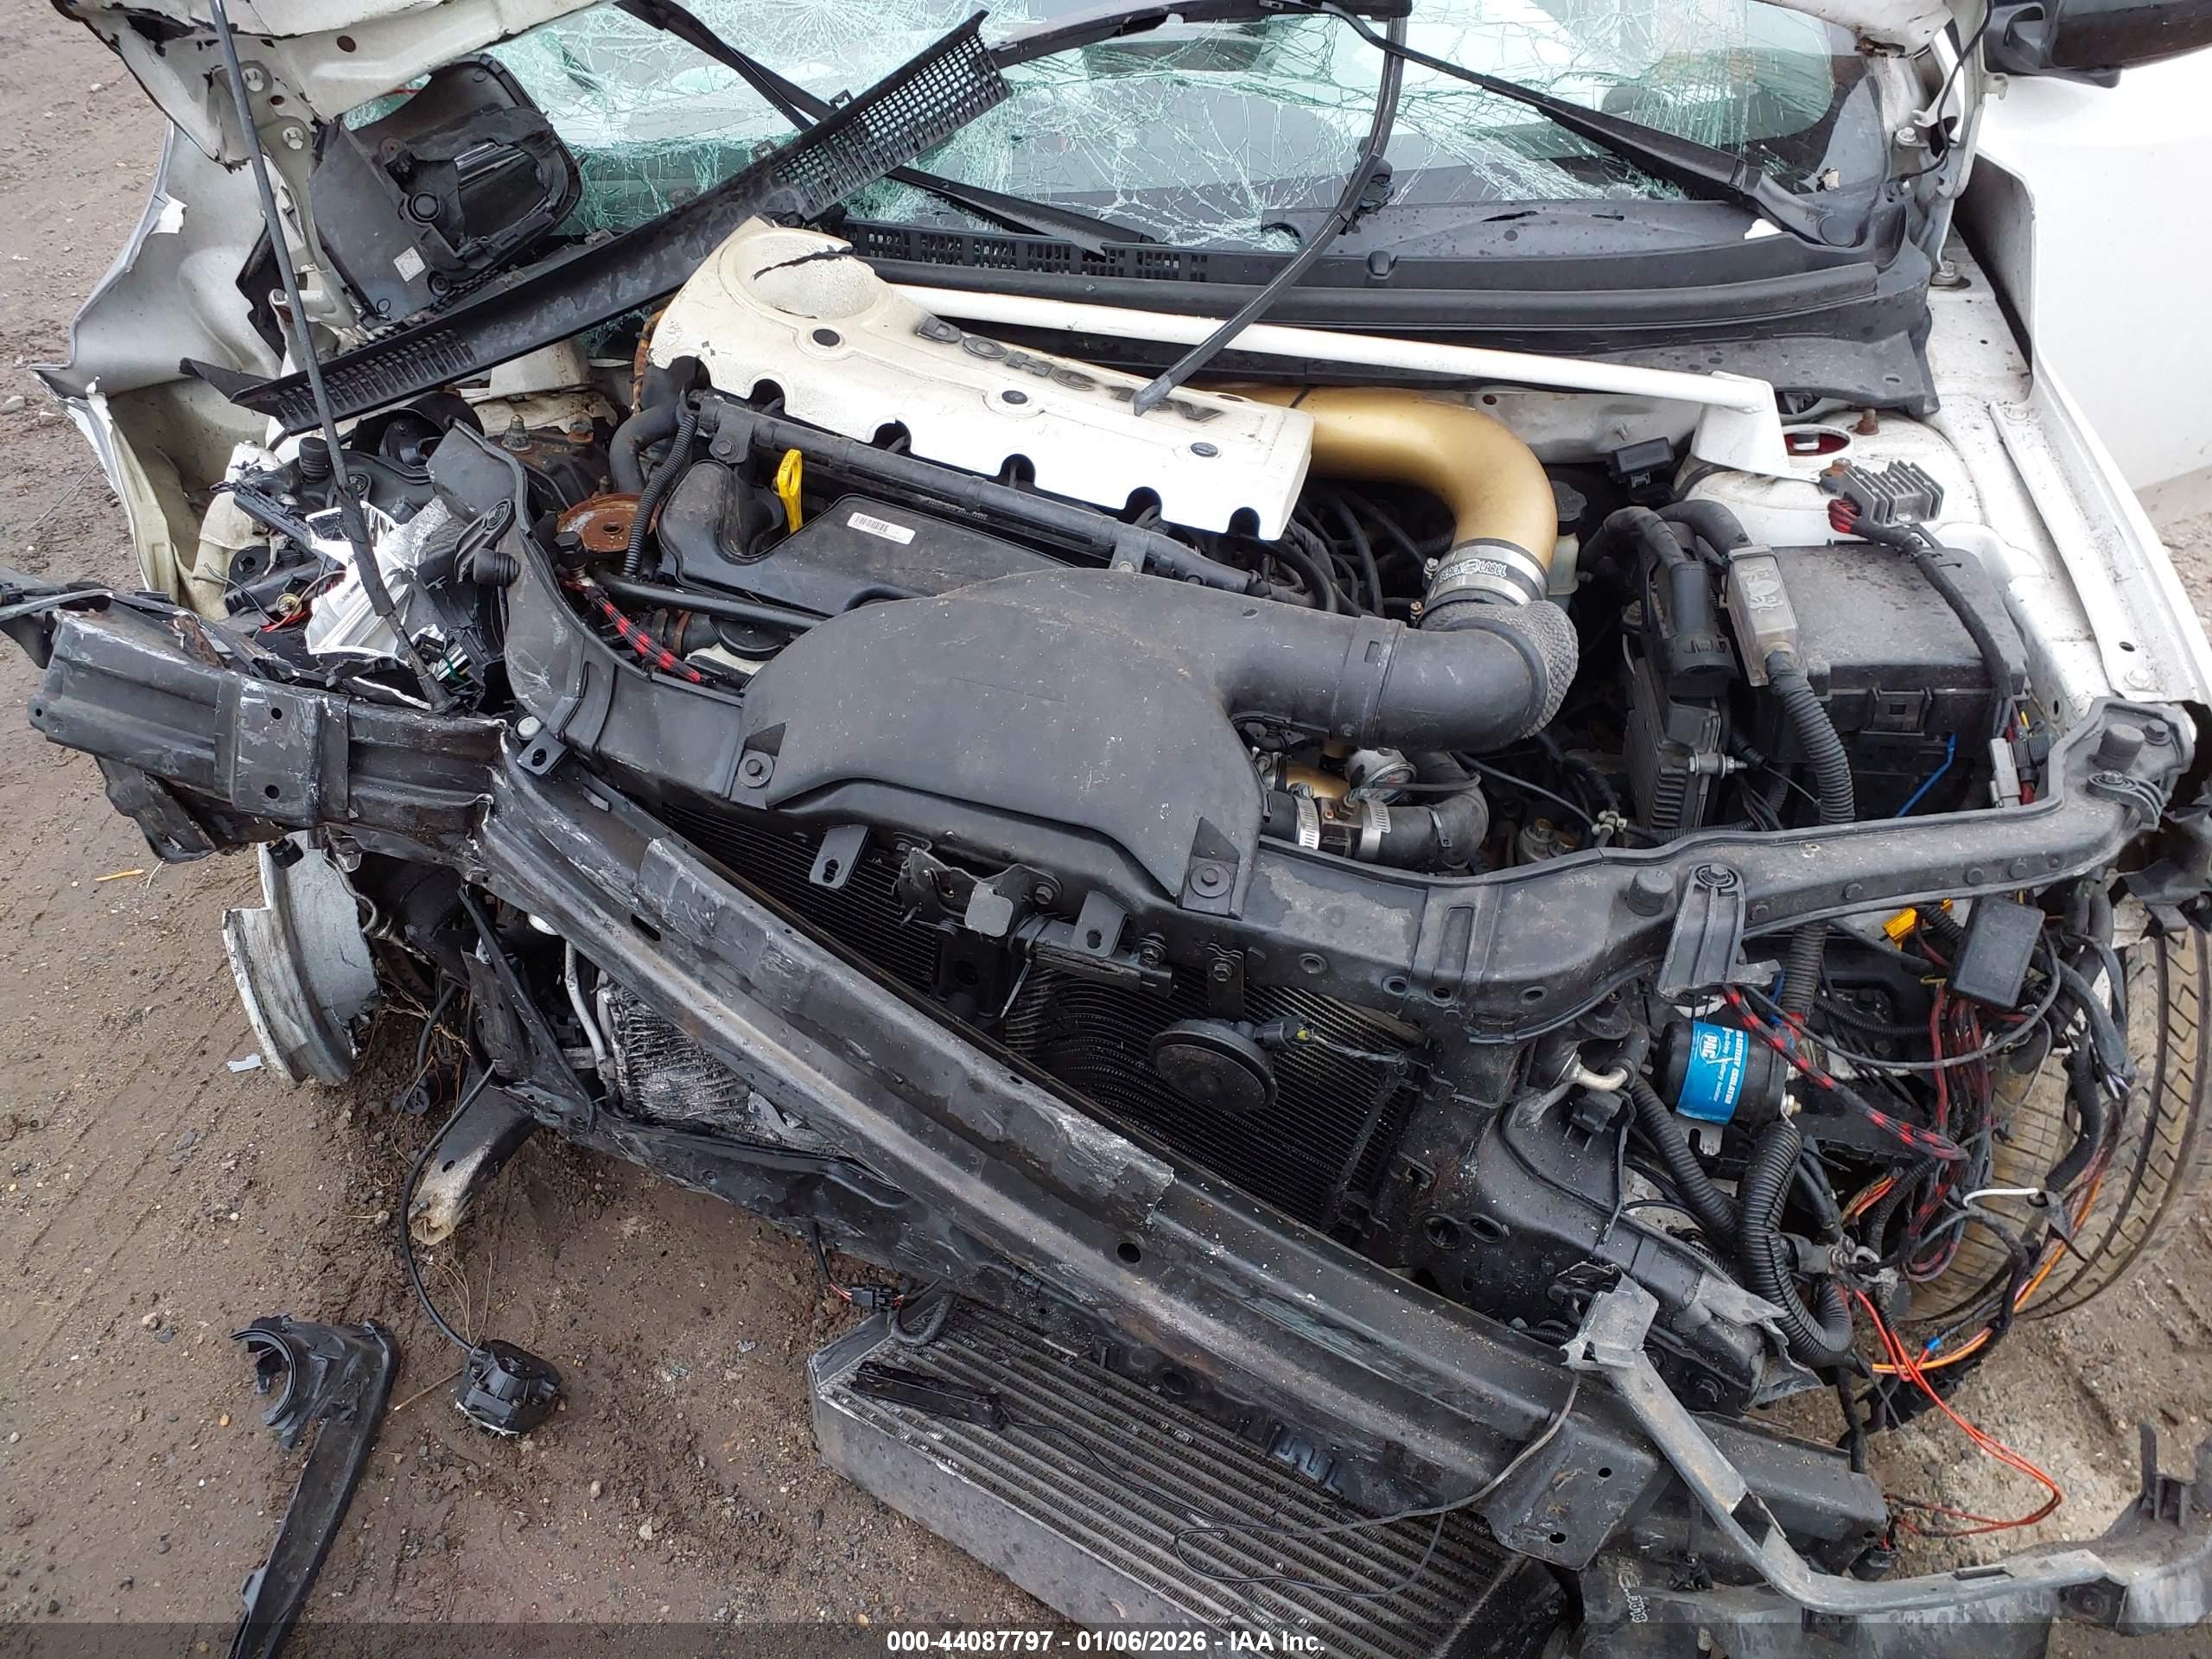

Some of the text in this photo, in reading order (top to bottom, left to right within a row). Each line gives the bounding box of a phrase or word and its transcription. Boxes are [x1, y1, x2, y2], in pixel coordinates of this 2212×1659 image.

[916, 313, 1097, 391] DOHC
[1479, 560, 1507, 577] LABEL
[1701, 1034, 1718, 1058] PAC
[1624, 1592, 1648, 1623] BLAC
